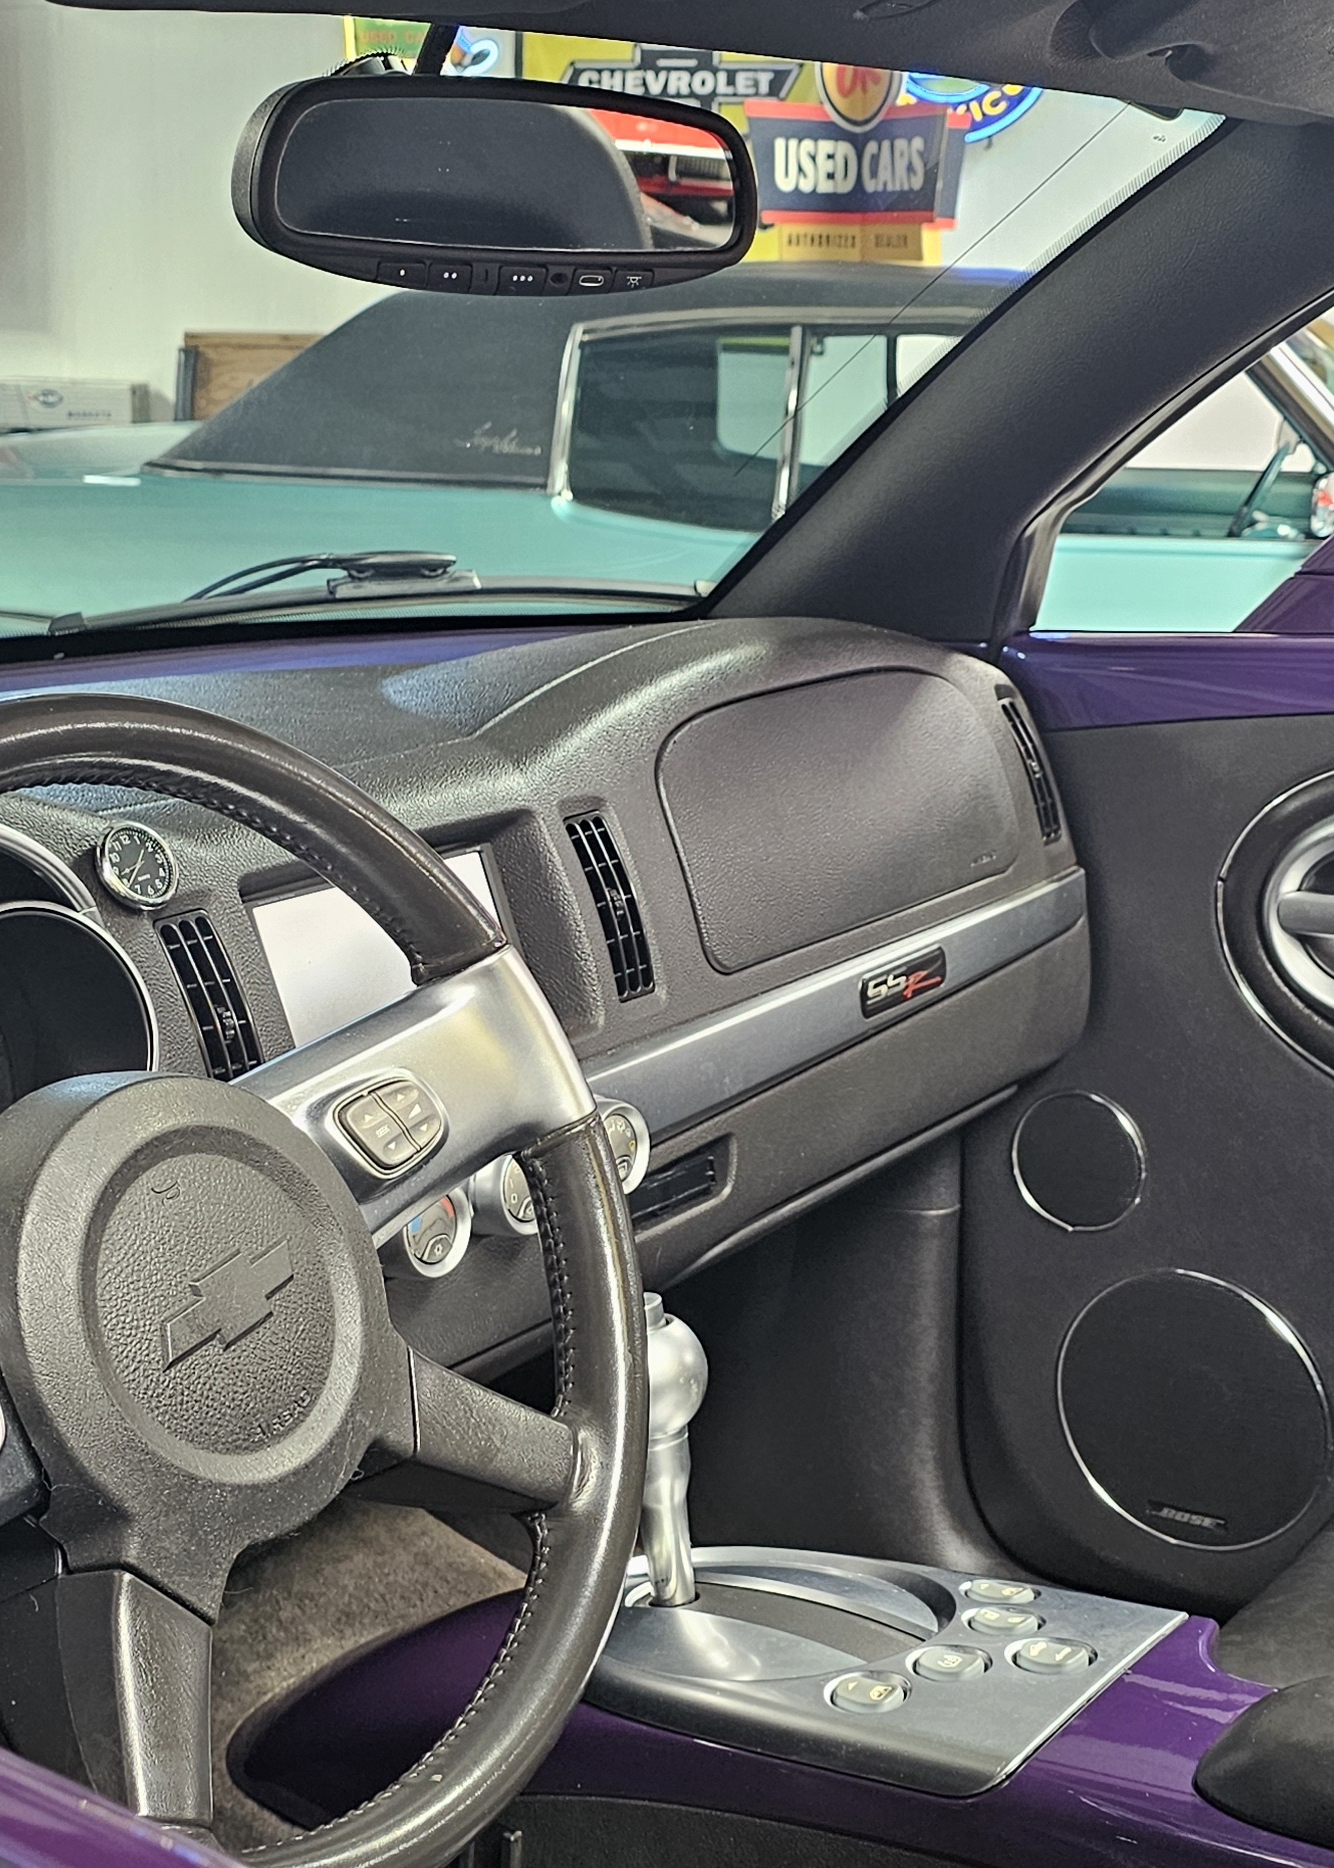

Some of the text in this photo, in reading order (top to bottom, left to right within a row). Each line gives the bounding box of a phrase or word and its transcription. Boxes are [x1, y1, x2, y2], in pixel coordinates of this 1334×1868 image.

[577, 68, 775, 97] CHEVROLET
[773, 136, 925, 193] USED CARS
[120, 834, 131, 845] 12
[109, 852, 120, 863] 10
[867, 967, 942, 1005] SSR
[1149, 1507, 1225, 1529] BOSE
